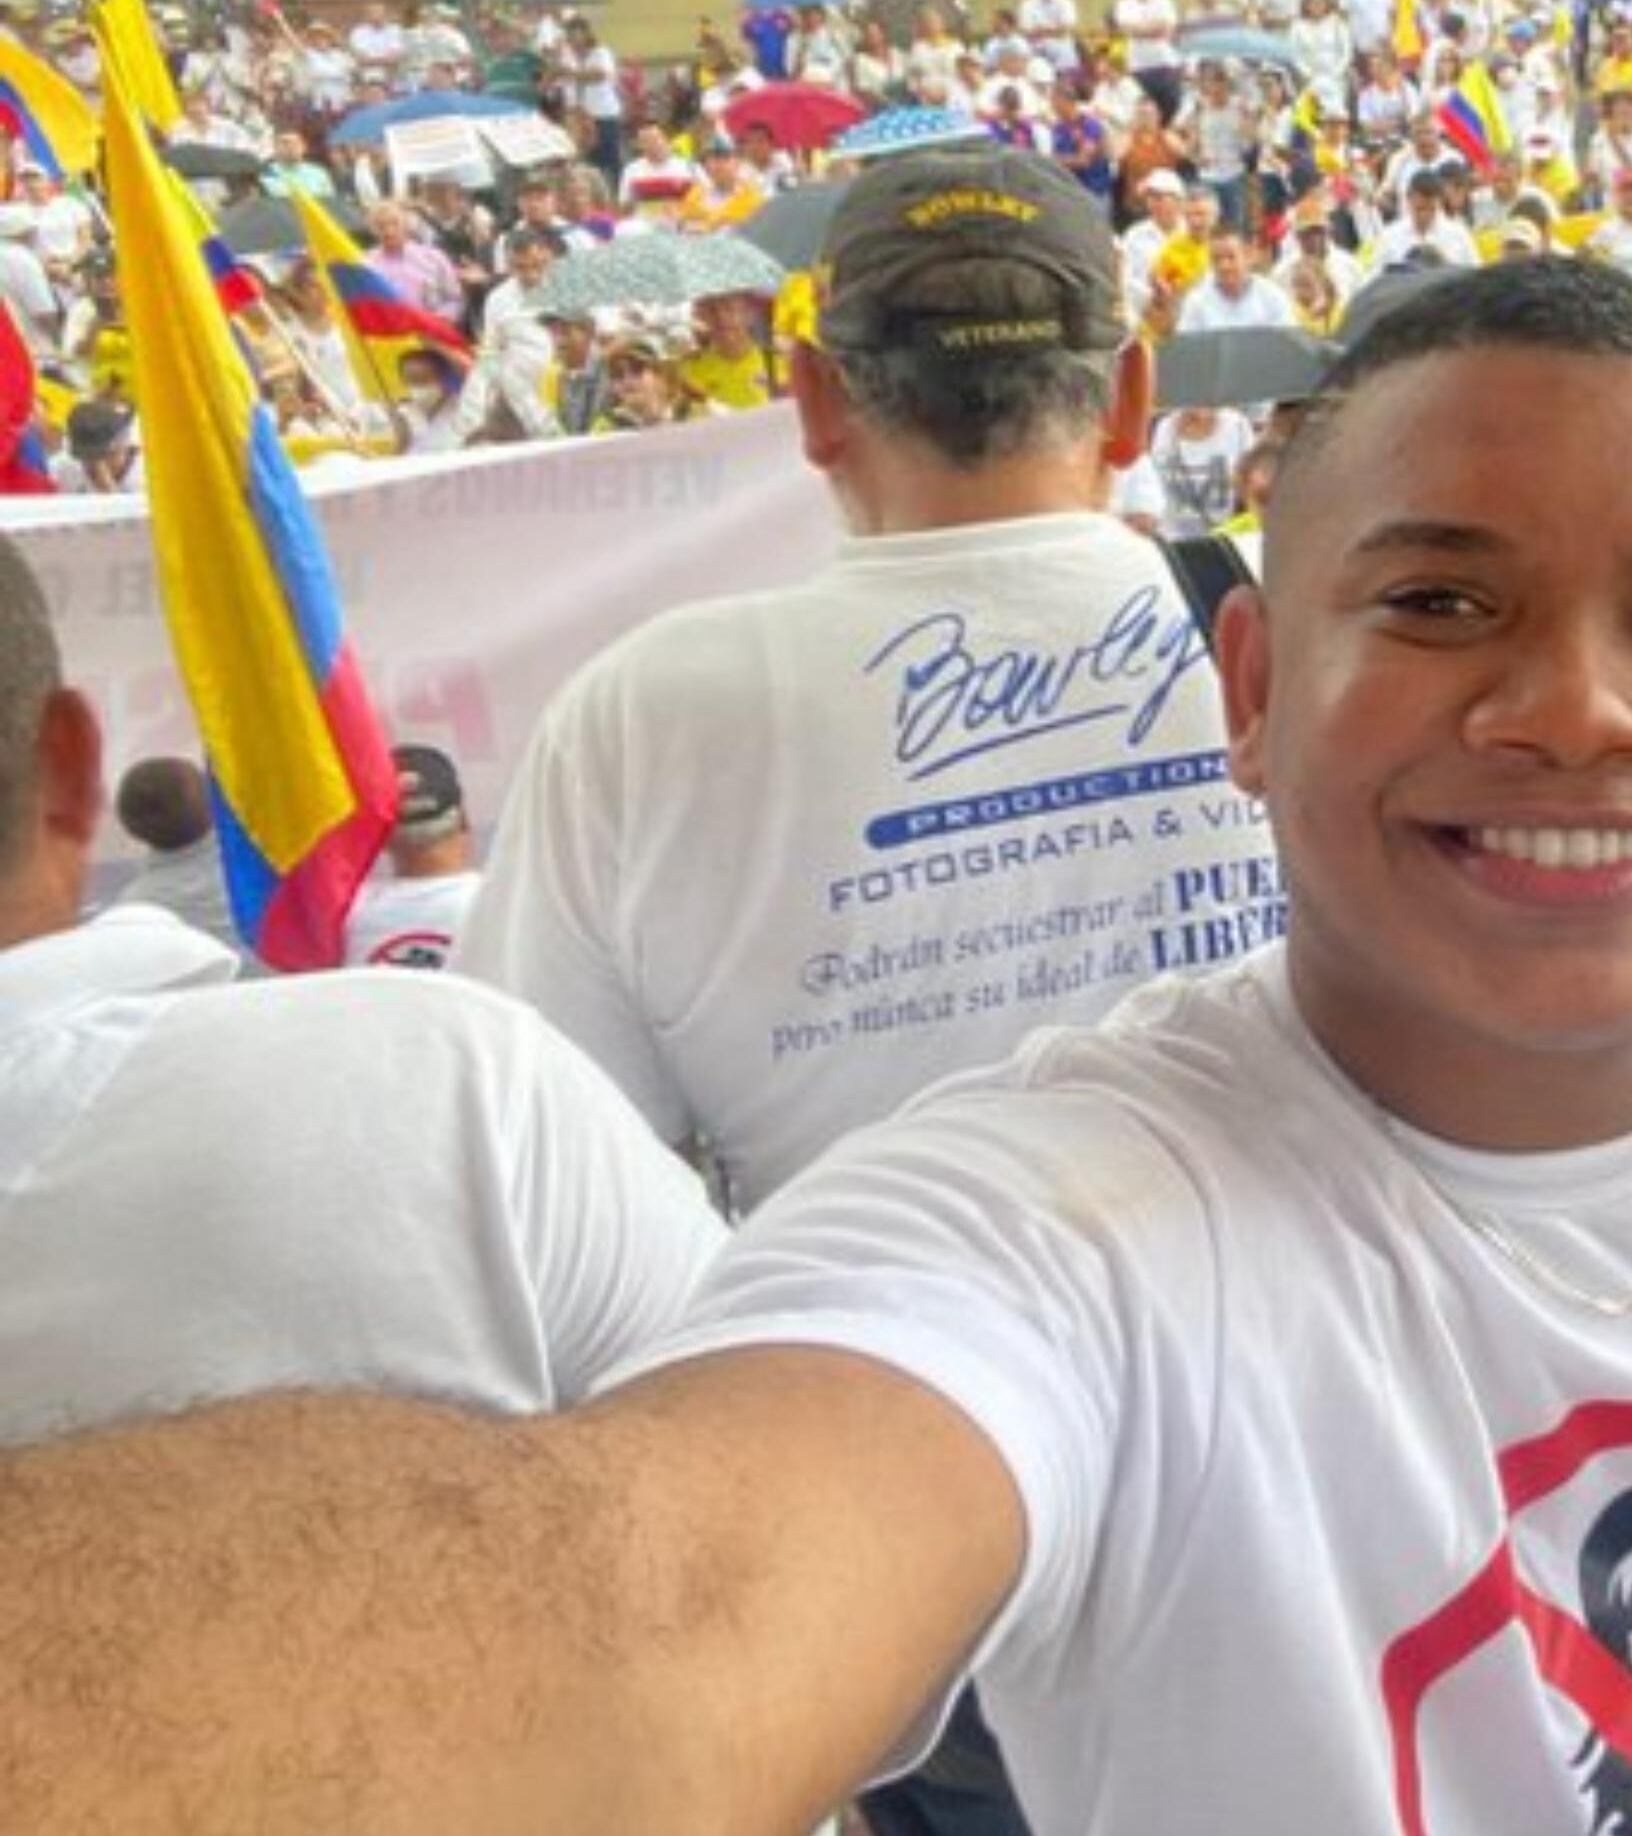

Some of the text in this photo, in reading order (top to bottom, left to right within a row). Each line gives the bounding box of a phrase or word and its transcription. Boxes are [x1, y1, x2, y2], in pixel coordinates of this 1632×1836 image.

[829, 817, 1135, 913] FOTOGRAFIA
[1152, 809, 1183, 839] &
[953, 898, 1124, 962] secuestrar
[1132, 879, 1164, 918] al
[771, 1017, 843, 1066] pero
[851, 991, 955, 1033] nunca
[962, 982, 1004, 1014] su
[1015, 949, 1098, 1001] ideal
[1104, 940, 1140, 979] de
